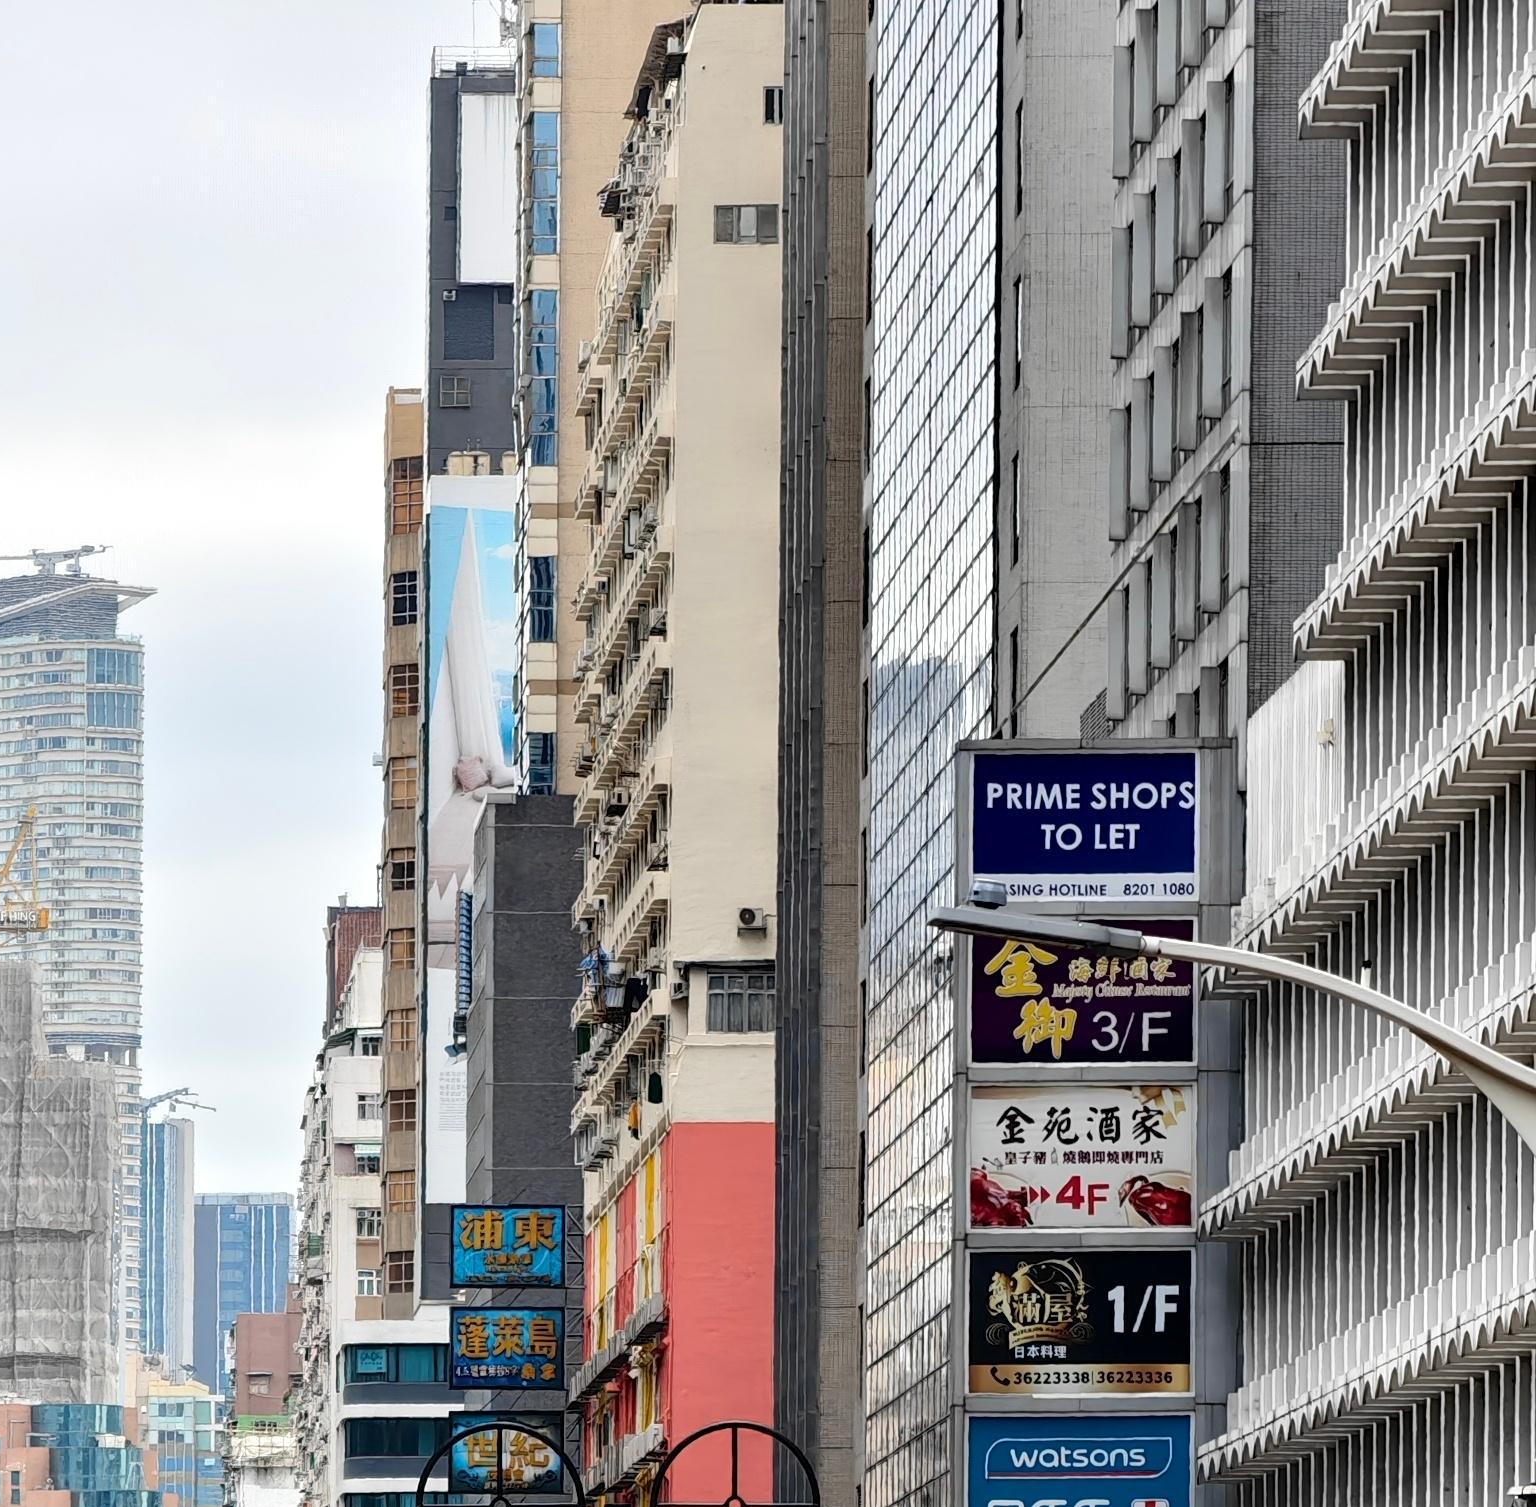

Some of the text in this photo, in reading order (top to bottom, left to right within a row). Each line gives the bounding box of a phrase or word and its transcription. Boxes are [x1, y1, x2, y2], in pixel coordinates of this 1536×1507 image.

[986, 782, 1195, 810] PRIME SHOPS
[1041, 823, 1140, 850] TO LET
[1049, 883, 1107, 896] HOTLINE
[1123, 882, 1156, 895] 8201
[1161, 882, 1194, 895] 1080
[1091, 1011, 1172, 1053] 3/F
[996, 1106, 1167, 1145] 金苑酒家
[1055, 1175, 1110, 1216] 4F
[460, 1210, 557, 1250] 浦東
[1108, 1285, 1180, 1333] 1/F
[1014, 1345, 1067, 1359] 日本料理
[1014, 1371, 1173, 1385] 36223338 36223336
[1011, 1447, 1146, 1469] watsons
